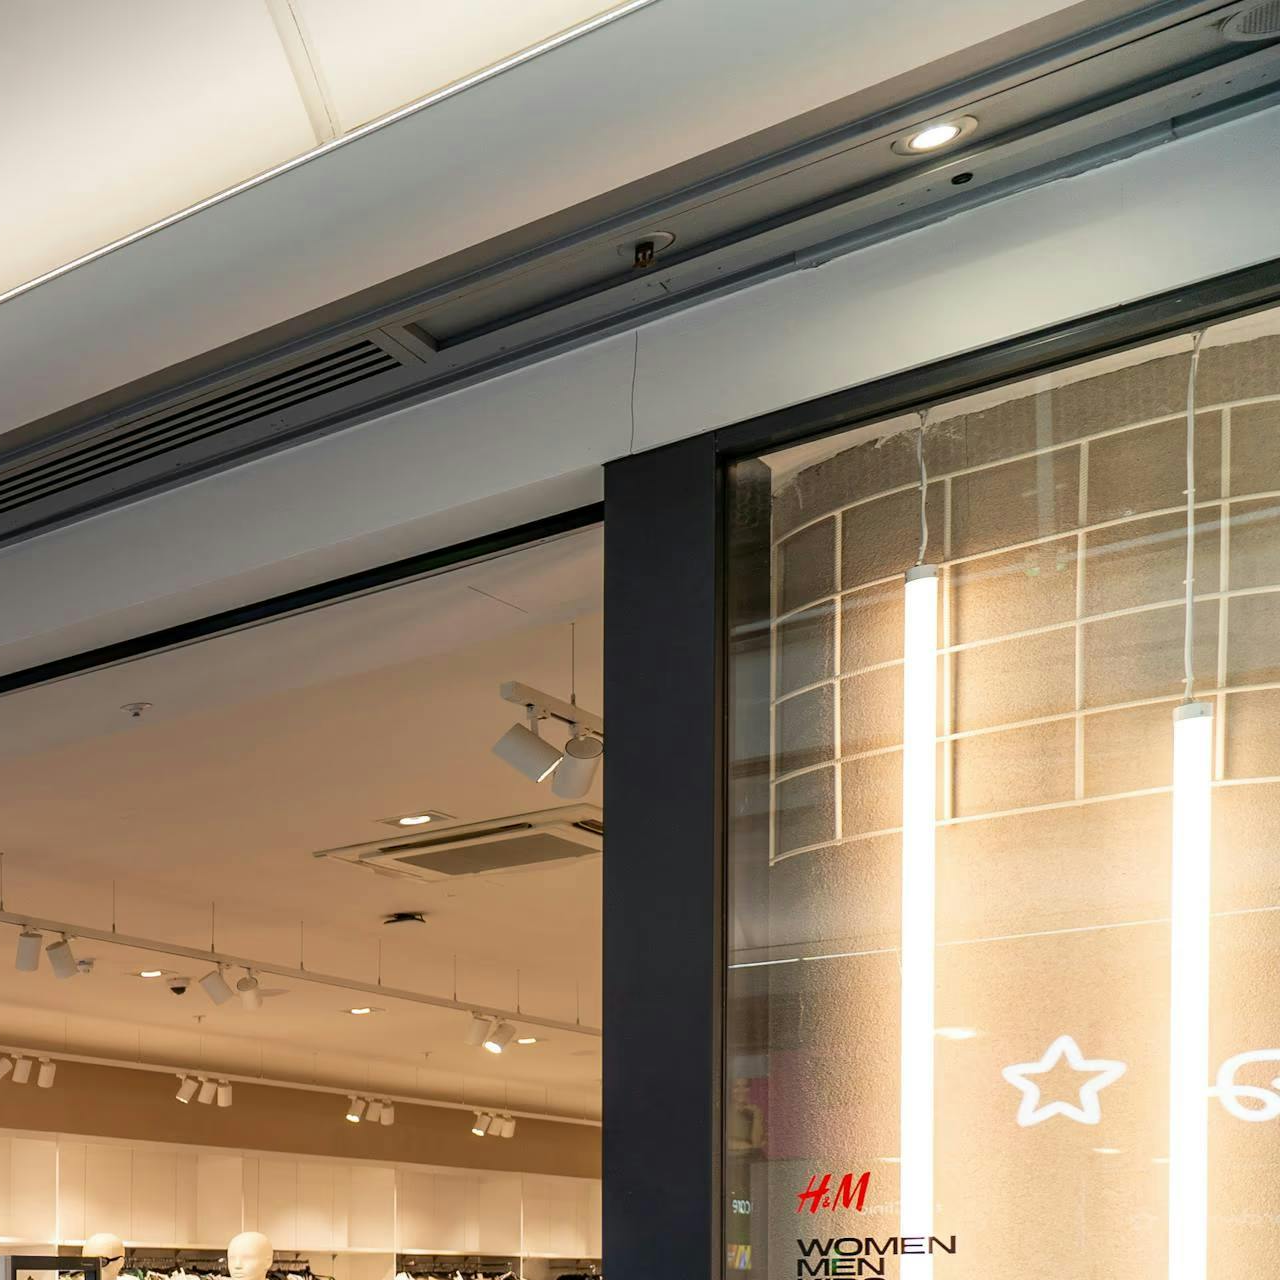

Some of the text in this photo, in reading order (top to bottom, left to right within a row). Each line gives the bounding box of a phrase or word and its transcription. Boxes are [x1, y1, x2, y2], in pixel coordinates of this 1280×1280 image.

[796, 1171, 871, 1214] H&M
[797, 1235, 956, 1256] WOMEN
[797, 1258, 885, 1276] MEN
